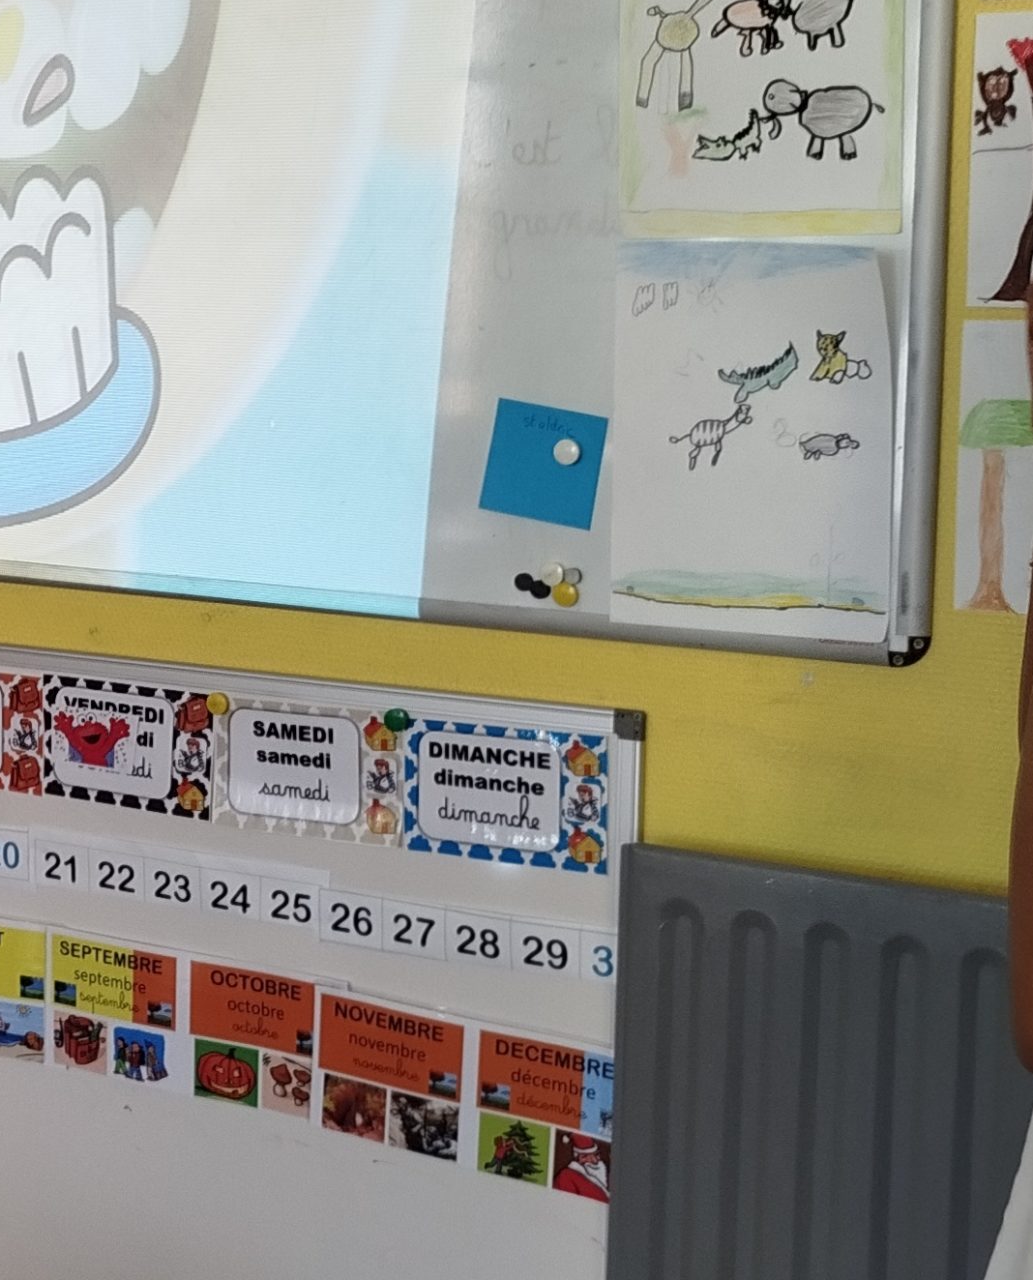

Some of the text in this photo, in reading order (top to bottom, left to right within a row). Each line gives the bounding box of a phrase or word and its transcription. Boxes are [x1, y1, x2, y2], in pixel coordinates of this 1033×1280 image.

[252, 720, 334, 745] SAMEDI
[256, 747, 332, 770] samedi
[428, 740, 552, 770] DIMANCHE
[258, 778, 332, 804] samedi
[433, 768, 546, 796] dimanche
[437, 794, 540, 831] dimanche
[44, 852, 76, 883] 21
[98, 861, 136, 893] 22
[154, 870, 191, 902] 23
[210, 881, 250, 914] 24
[270, 890, 312, 923] 25
[330, 902, 373, 936] 26
[393, 914, 436, 947] 27
[456, 925, 500, 959] 28
[522, 936, 568, 970] 29
[592, 946, 614, 977] 3
[59, 940, 162, 975] SEPTEMBRE
[74, 968, 146, 995] septembre
[210, 970, 302, 1002] OCTOBRE
[80, 990, 140, 1014] septembre
[227, 995, 284, 1021] octobre
[232, 1018, 278, 1040] octobre
[334, 1001, 444, 1042] NOVEMBRE
[348, 1032, 426, 1063] novembre
[495, 1040, 614, 1080] DECEMBRE
[352, 1056, 419, 1083] novembre
[511, 1068, 596, 1100] décembre
